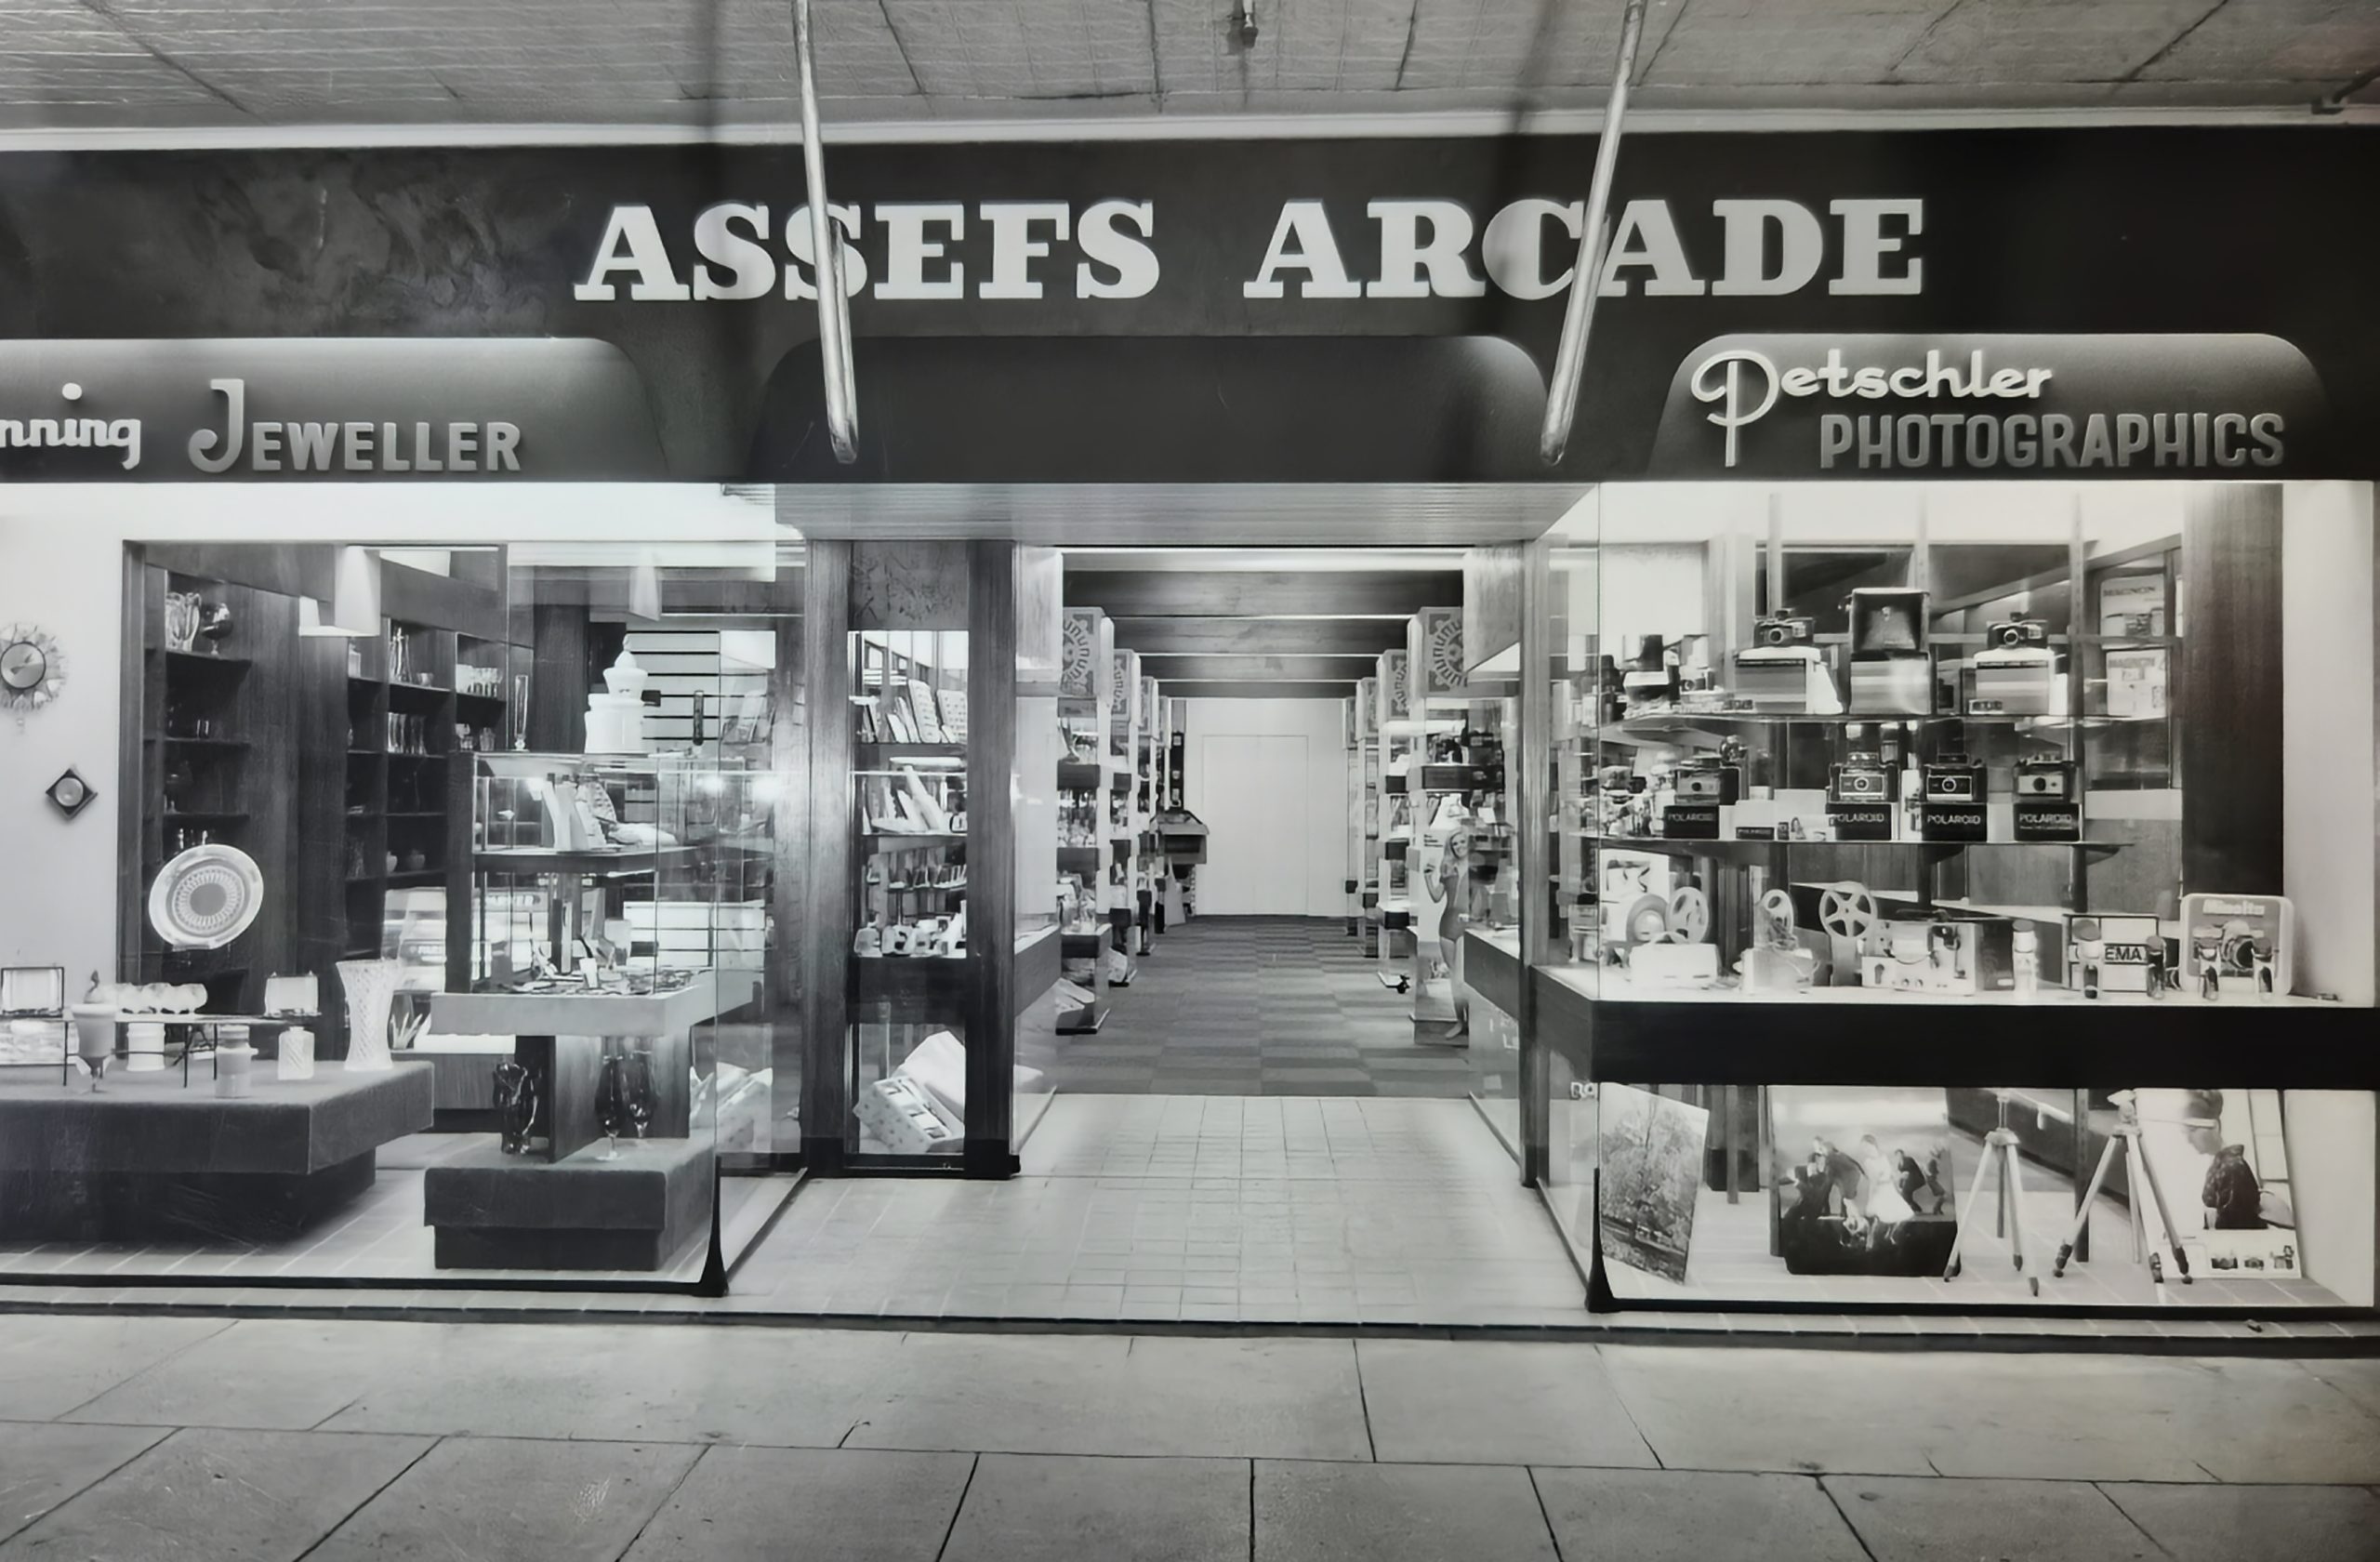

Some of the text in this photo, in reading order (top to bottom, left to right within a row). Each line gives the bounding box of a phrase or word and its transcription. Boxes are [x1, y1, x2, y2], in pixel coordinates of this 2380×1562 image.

[574, 198, 1924, 302] ASSEFS ARCADE
[188, 378, 522, 472] JEWELLER
[1690, 349, 2053, 468] Petschler
[1819, 413, 2285, 469] PHOTOGRAPHICS
[1927, 814, 1981, 825] POLAROID
[2018, 813, 2073, 824] POLAROID
